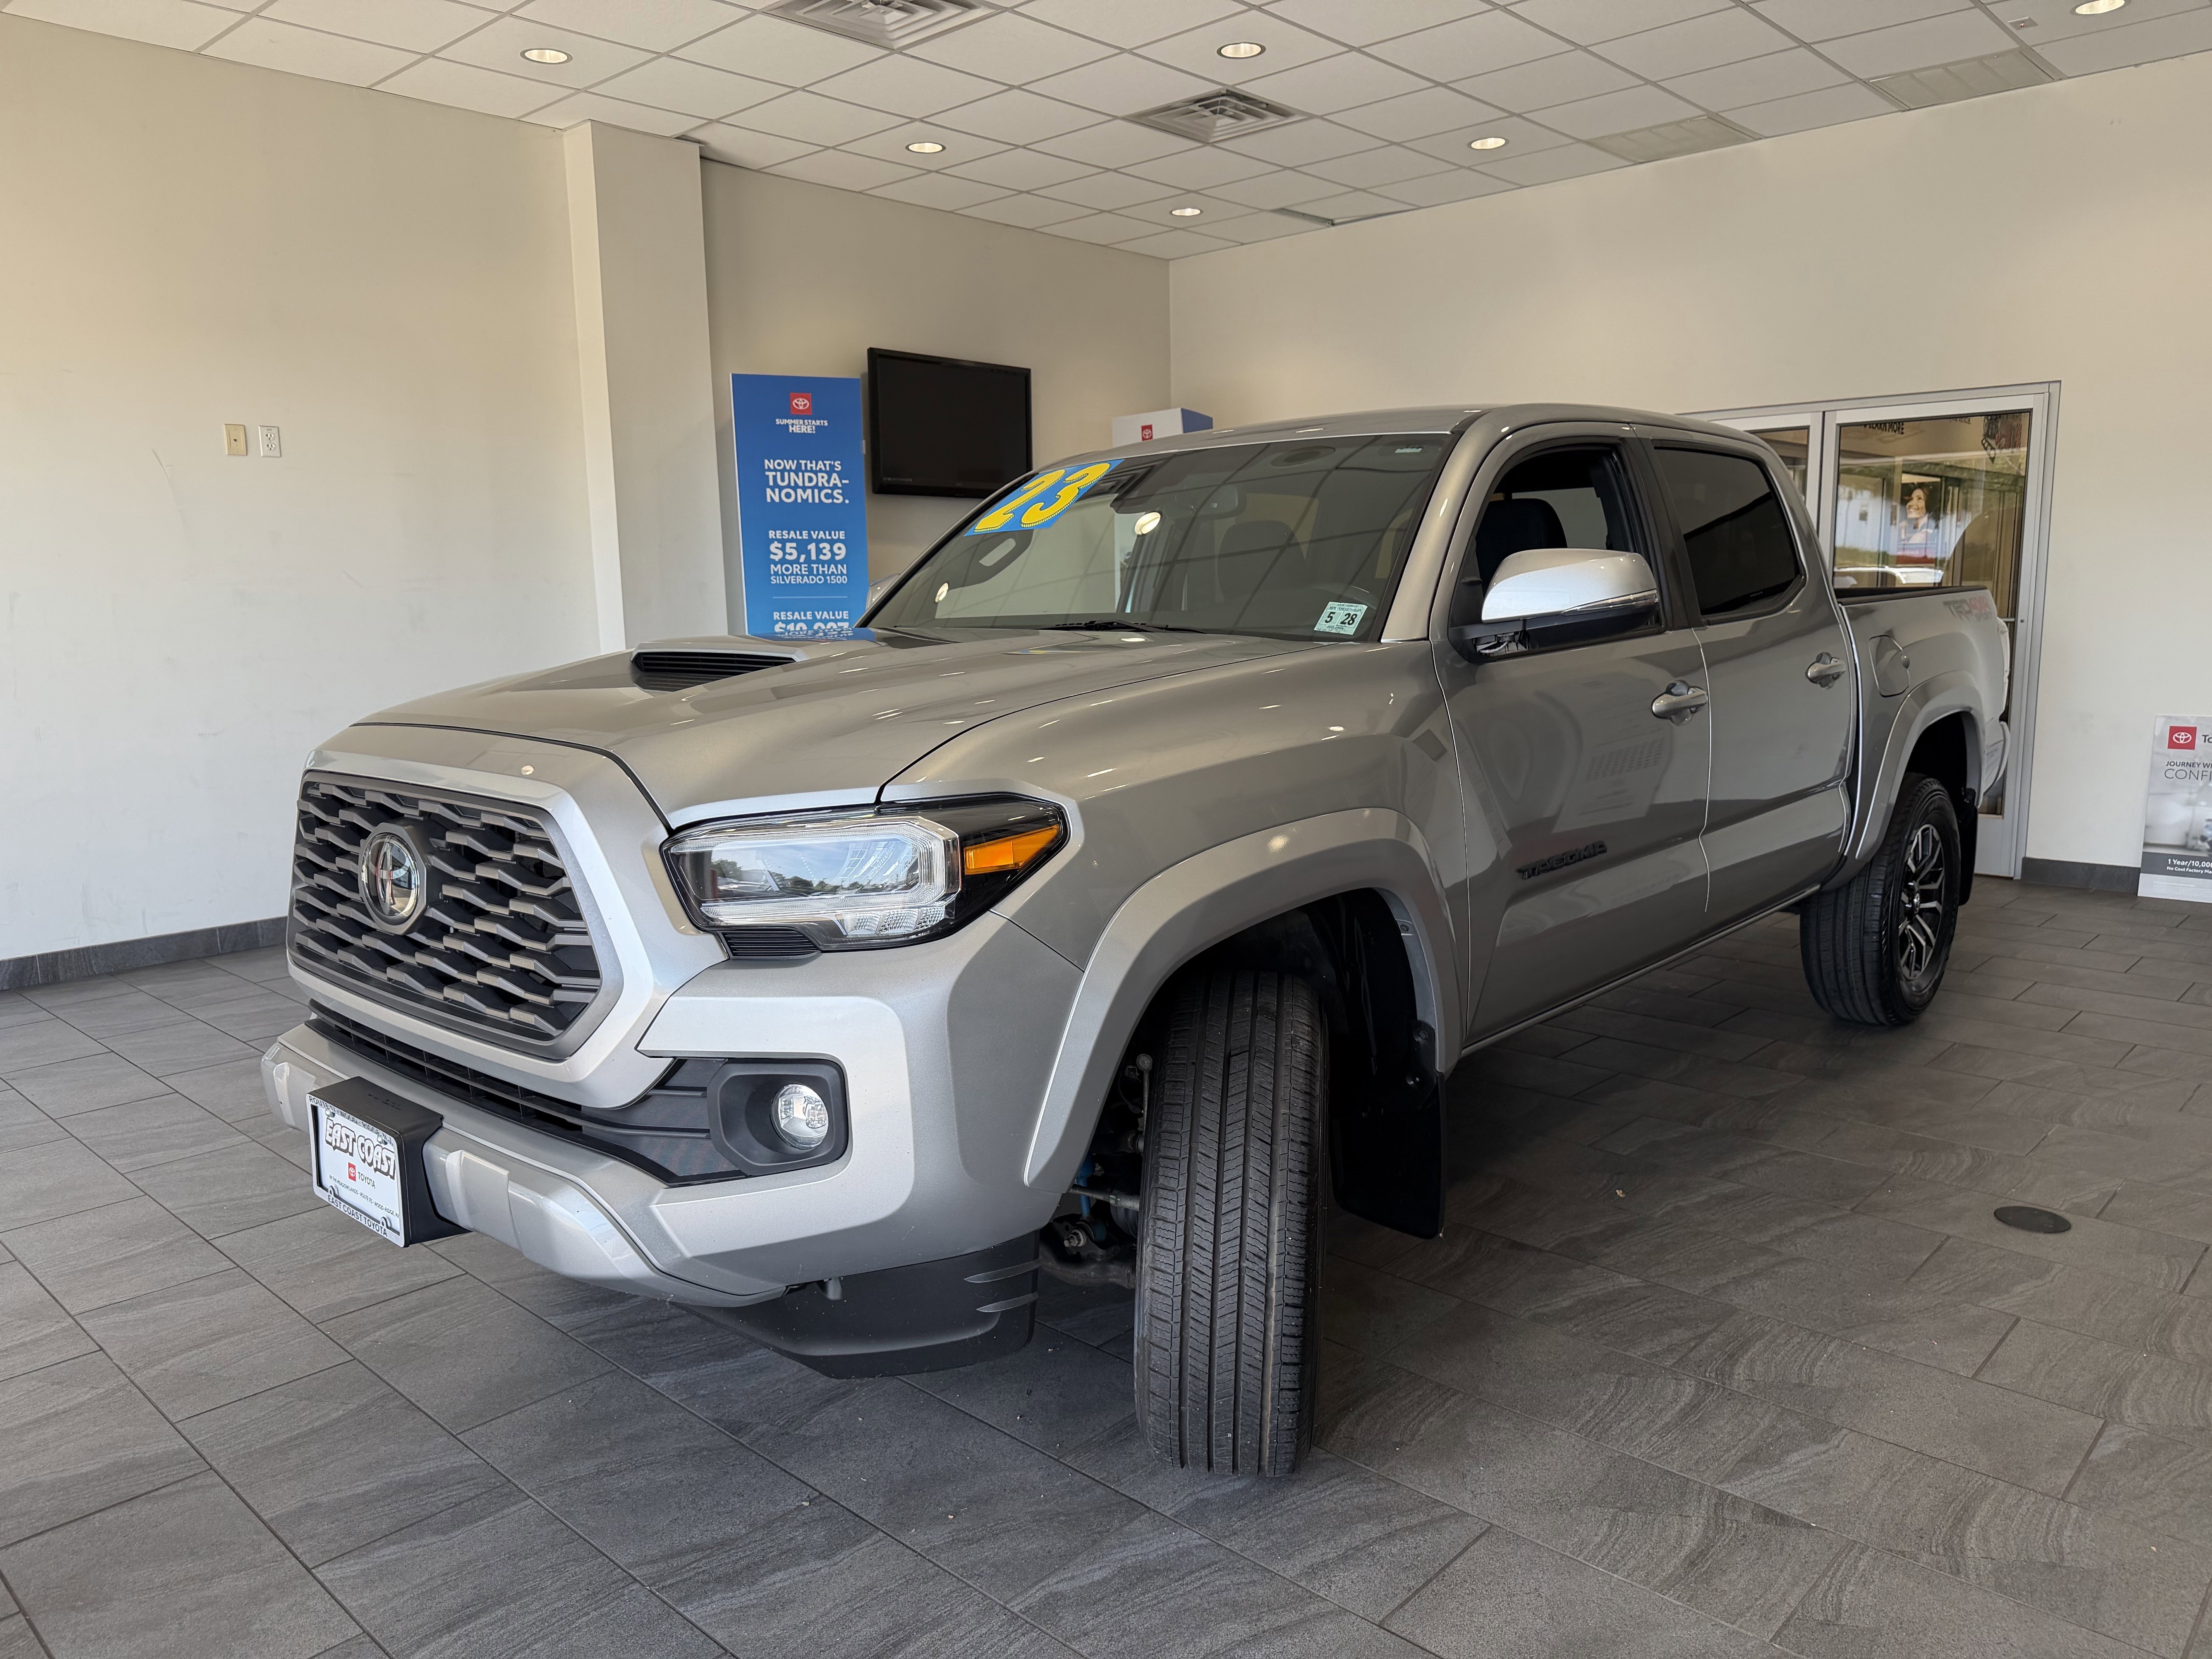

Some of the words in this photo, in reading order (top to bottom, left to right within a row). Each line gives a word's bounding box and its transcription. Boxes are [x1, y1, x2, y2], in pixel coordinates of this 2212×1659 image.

[789, 425, 815, 433] HERE!
[764, 459, 797, 470] NOW
[799, 460, 842, 471] THAT'S
[765, 472, 849, 487] TUNDRA-
[766, 488, 849, 503] NOMICS.
[974, 463, 1110, 532] 23
[769, 530, 809, 539] RESALE
[811, 531, 845, 539] VALUE
[769, 541, 847, 562] $5,139
[770, 564, 809, 574] MORE
[811, 564, 847, 574] THAN
[771, 575, 824, 584] SILVERADO
[826, 575, 847, 584] 1500
[773, 611, 812, 620] RESALE
[815, 611, 849, 619] VALUE
[1325, 612, 1336, 623] 5
[1340, 613, 1357, 625] 28
[2164, 768, 2212, 781] CONFI
[1515, 841, 1607, 879] TACOMA
[309, 1096, 330, 1109] ROUTE
[325, 1117, 356, 1158] EAST
[357, 1135, 396, 1181] COAST
[357, 1171, 376, 1189] TOYOTA
[328, 1194, 341, 1209] EAST
[343, 1204, 362, 1221] COAST
[364, 1217, 388, 1237] TOYOTA
